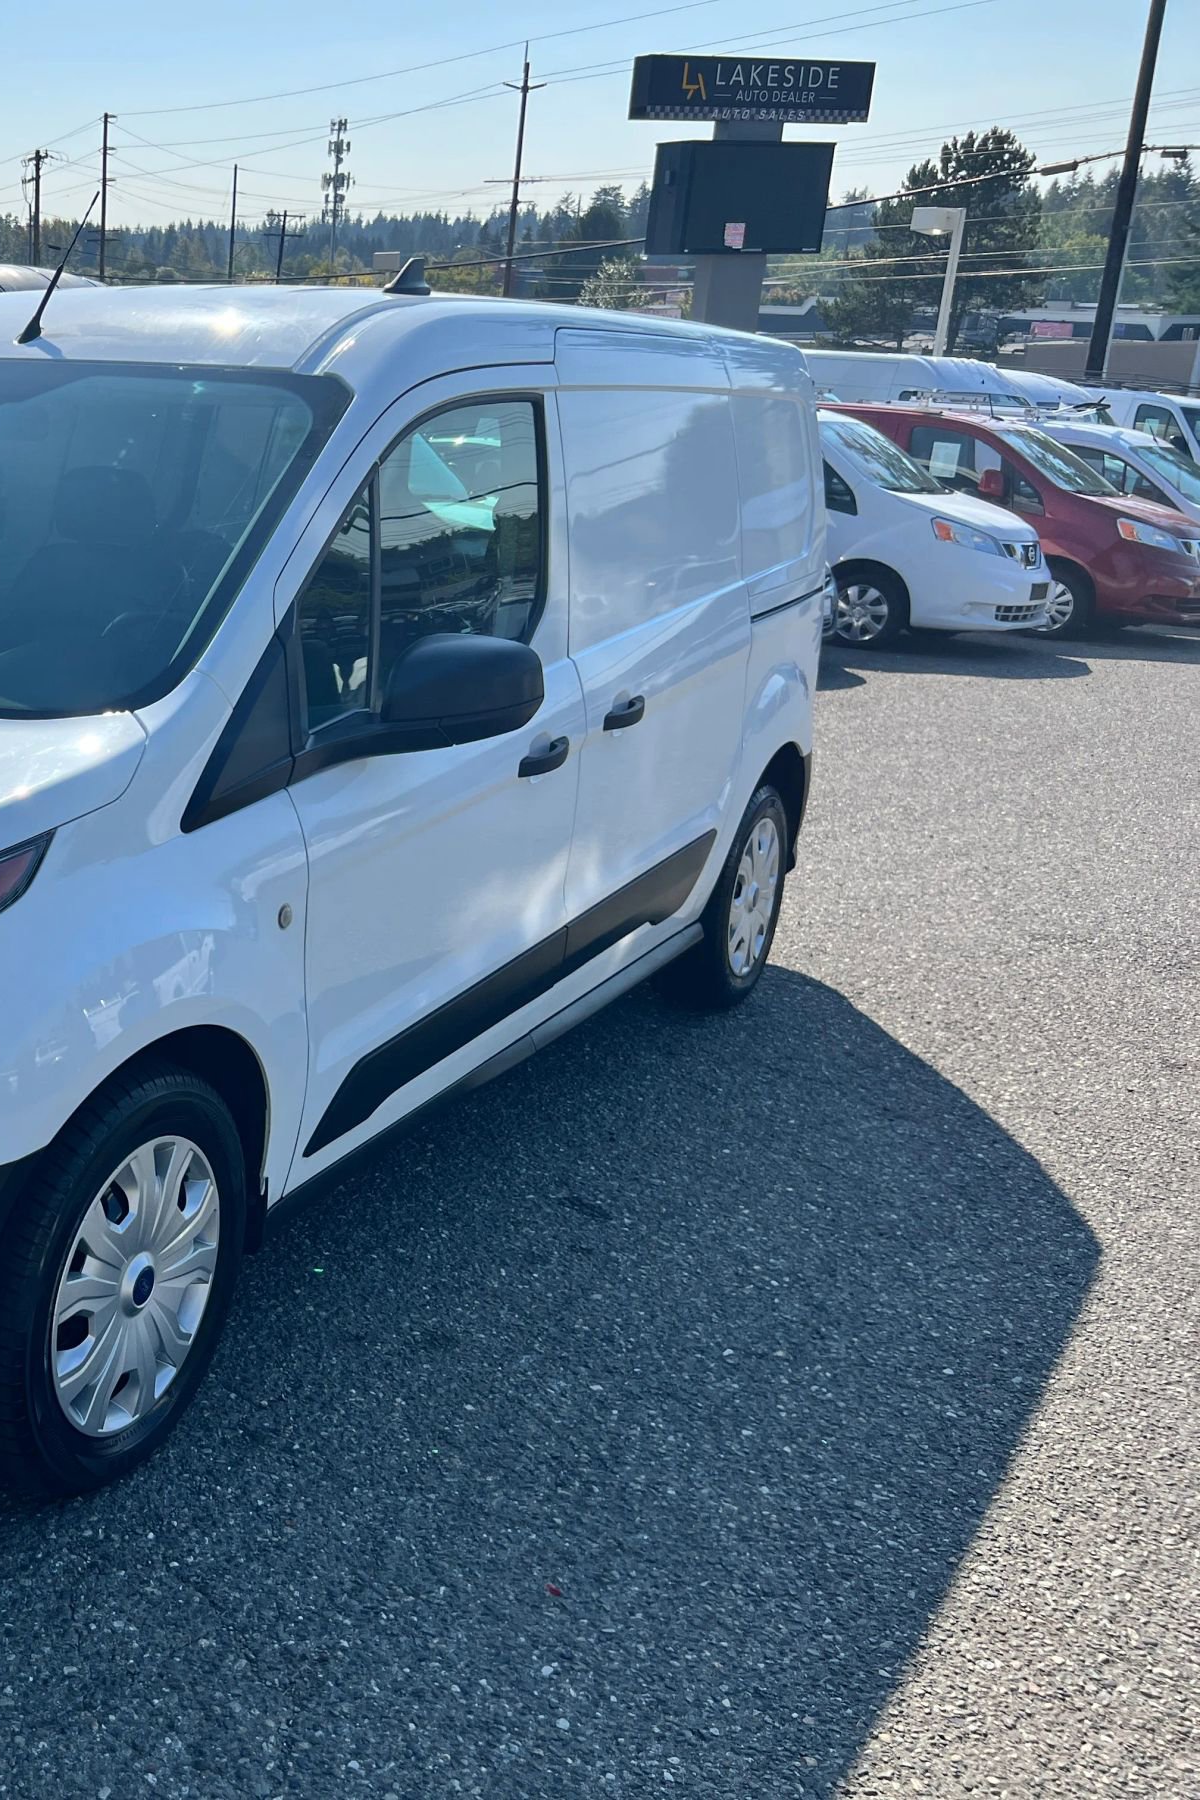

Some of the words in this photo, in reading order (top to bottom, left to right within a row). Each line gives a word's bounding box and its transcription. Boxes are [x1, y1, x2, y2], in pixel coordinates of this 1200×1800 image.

[715, 63, 841, 89] LAKESIDE
[735, 90, 769, 103] AUTO
[772, 91, 816, 104] DEALER
[711, 109, 750, 120] AUTO
[758, 109, 807, 121] SALES
